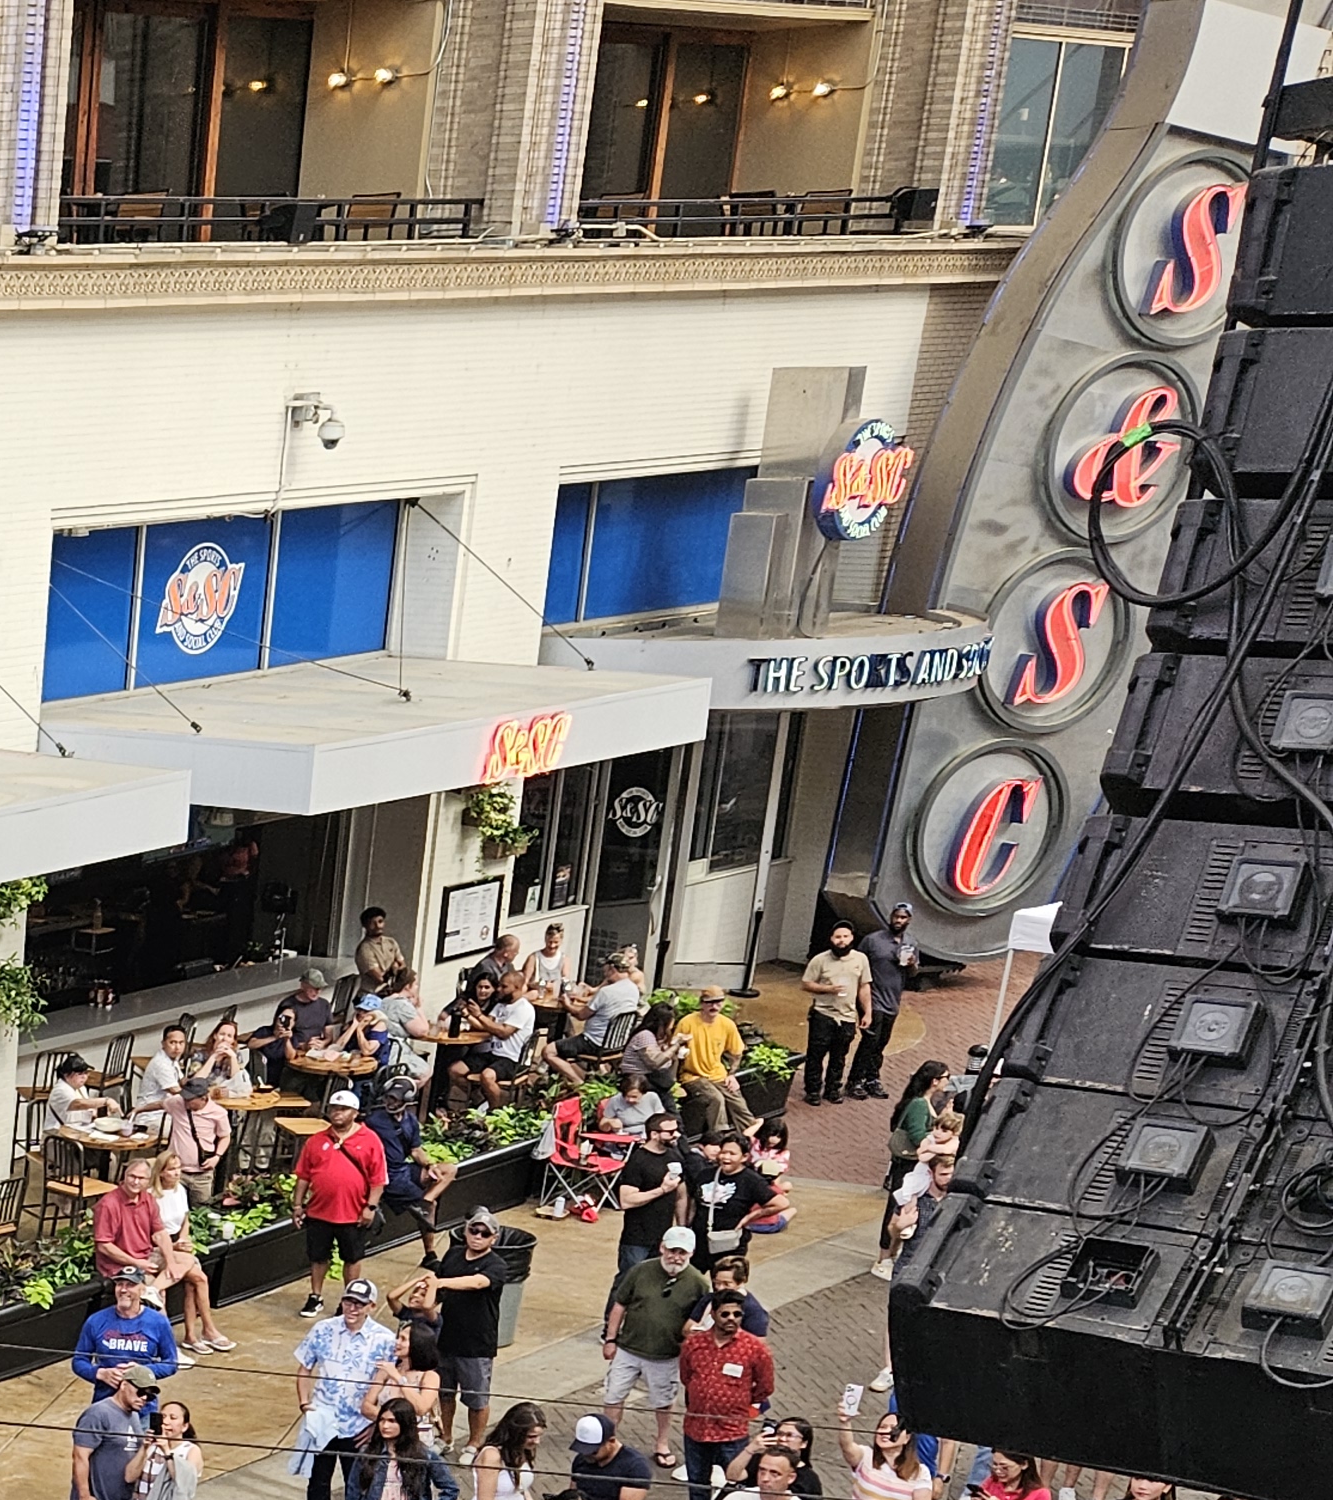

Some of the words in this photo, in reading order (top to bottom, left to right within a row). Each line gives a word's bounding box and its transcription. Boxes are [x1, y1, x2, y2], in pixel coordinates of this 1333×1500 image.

[820, 446, 914, 514] S&SC
[186, 551, 199, 570] THE
[199, 549, 222, 567] SPORTS
[158, 566, 242, 629] S&SC
[748, 656, 808, 693] THE
[913, 648, 958, 686] AND
[482, 713, 573, 785] S&SC
[607, 798, 663, 824] S&SC
